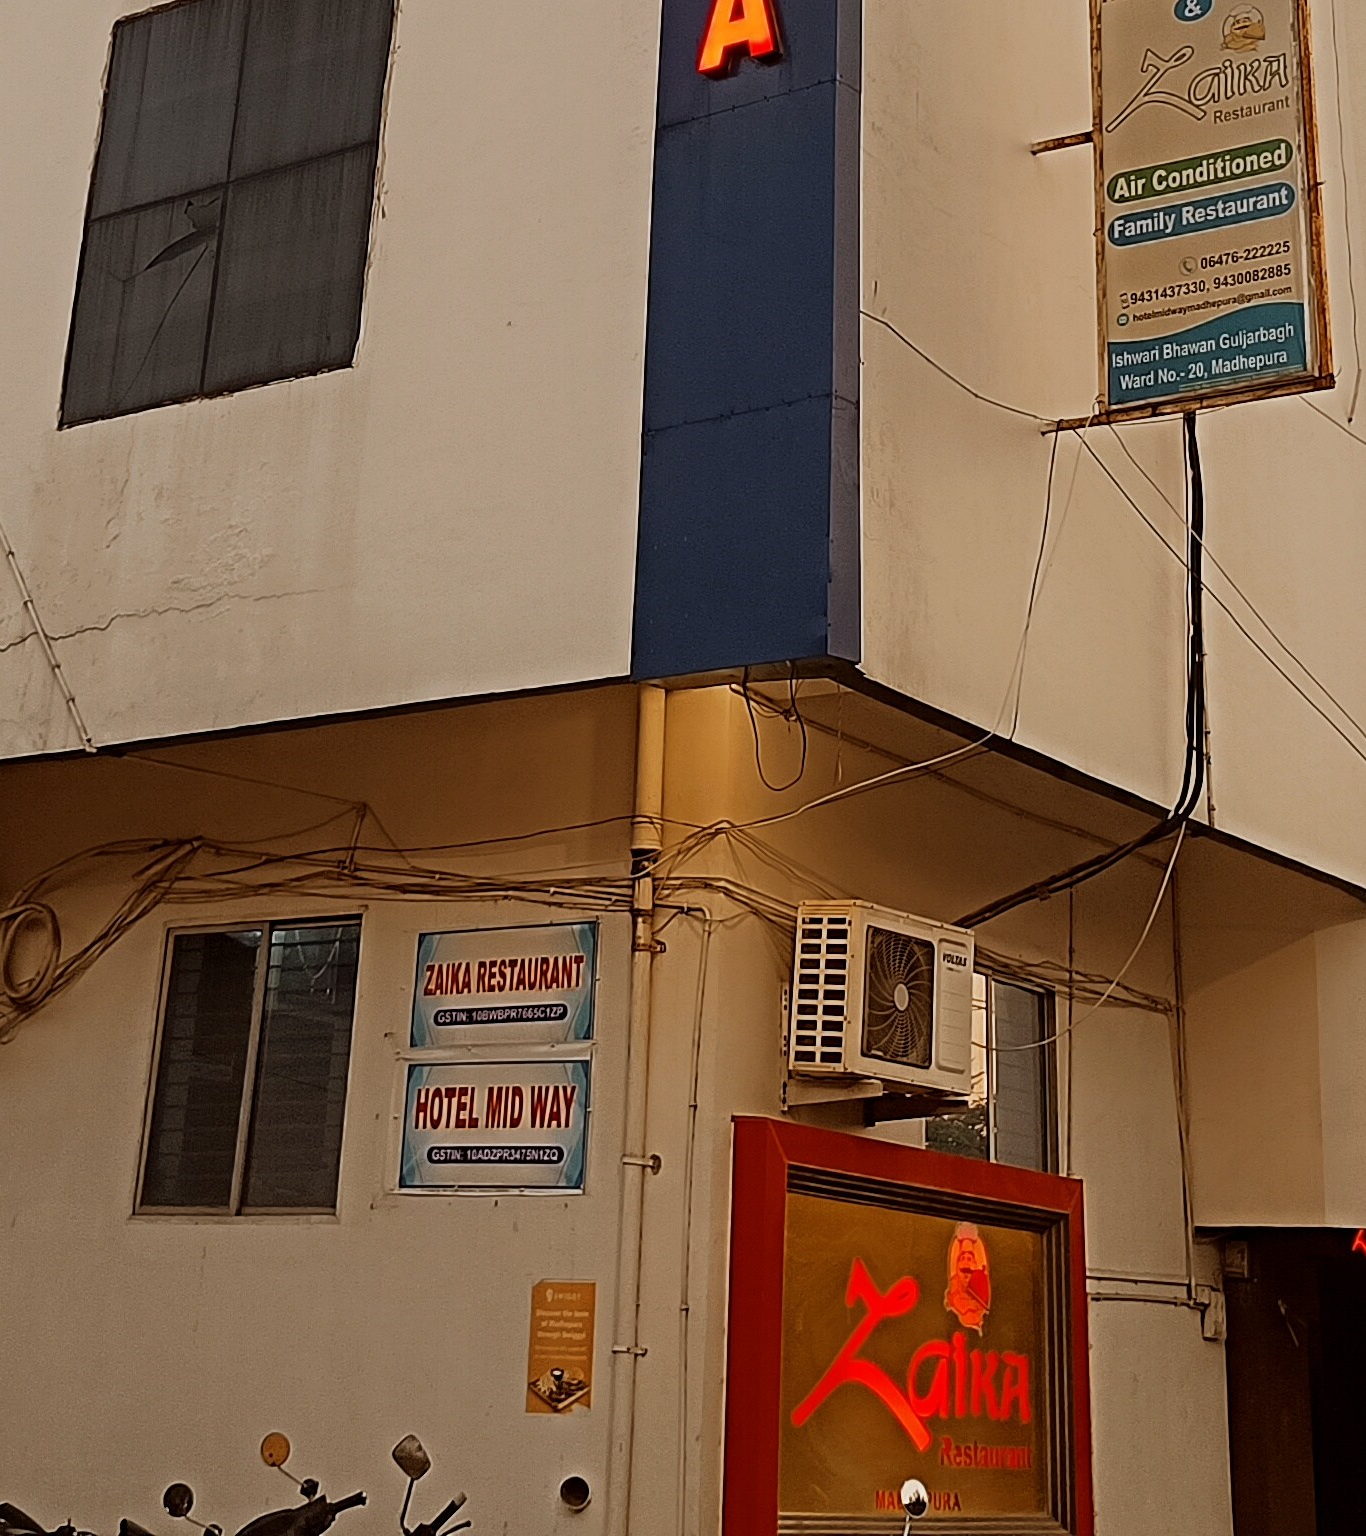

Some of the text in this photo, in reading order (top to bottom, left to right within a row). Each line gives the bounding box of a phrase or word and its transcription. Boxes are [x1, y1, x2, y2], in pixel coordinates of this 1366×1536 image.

[1213, 96, 1291, 124] Restaurant
[1113, 143, 1287, 200] Air Conditioned
[1113, 187, 1290, 239] Family Restaurant
[1200, 240, 1291, 270] 06476-222225
[1130, 263, 1292, 305] 9431437330, 9430082885
[1112, 323, 1295, 368] Ishwari Bhawan Guljarbagh
[1120, 368, 1155, 390] Ward
[1188, 361, 1208, 381] 20,
[1211, 350, 1288, 374] Madhepura
[423, 954, 585, 996] ZAIKA RESTAURANT
[437, 1011, 470, 1023] GSTIN:
[414, 1085, 577, 1130] HOTEL MID WAY
[431, 1148, 464, 1160] GSTIN:
[940, 1434, 1032, 1469] Restaurant
